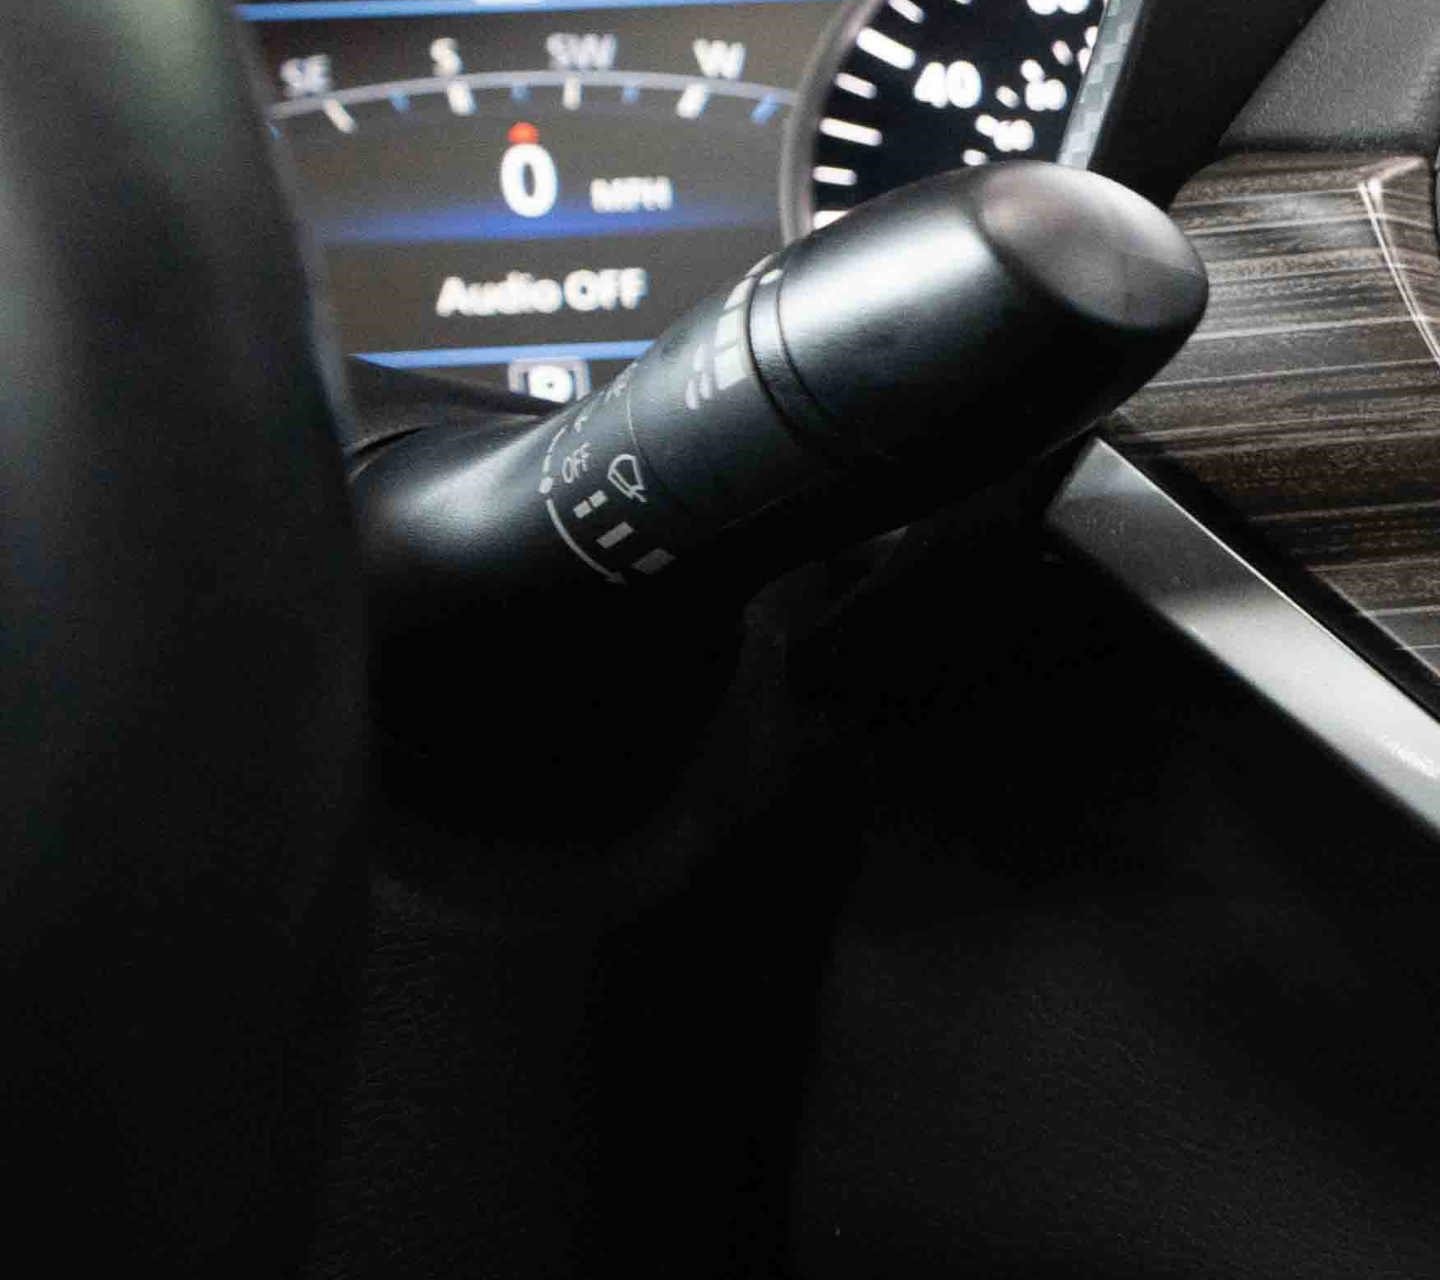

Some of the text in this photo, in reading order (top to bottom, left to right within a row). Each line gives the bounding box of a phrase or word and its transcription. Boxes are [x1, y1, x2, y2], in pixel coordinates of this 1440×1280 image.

[430, 37, 463, 76] S
[693, 39, 746, 79] W
[914, 61, 982, 109] 40
[500, 143, 672, 217] 0 MPH
[436, 267, 645, 317] Audio OFF
